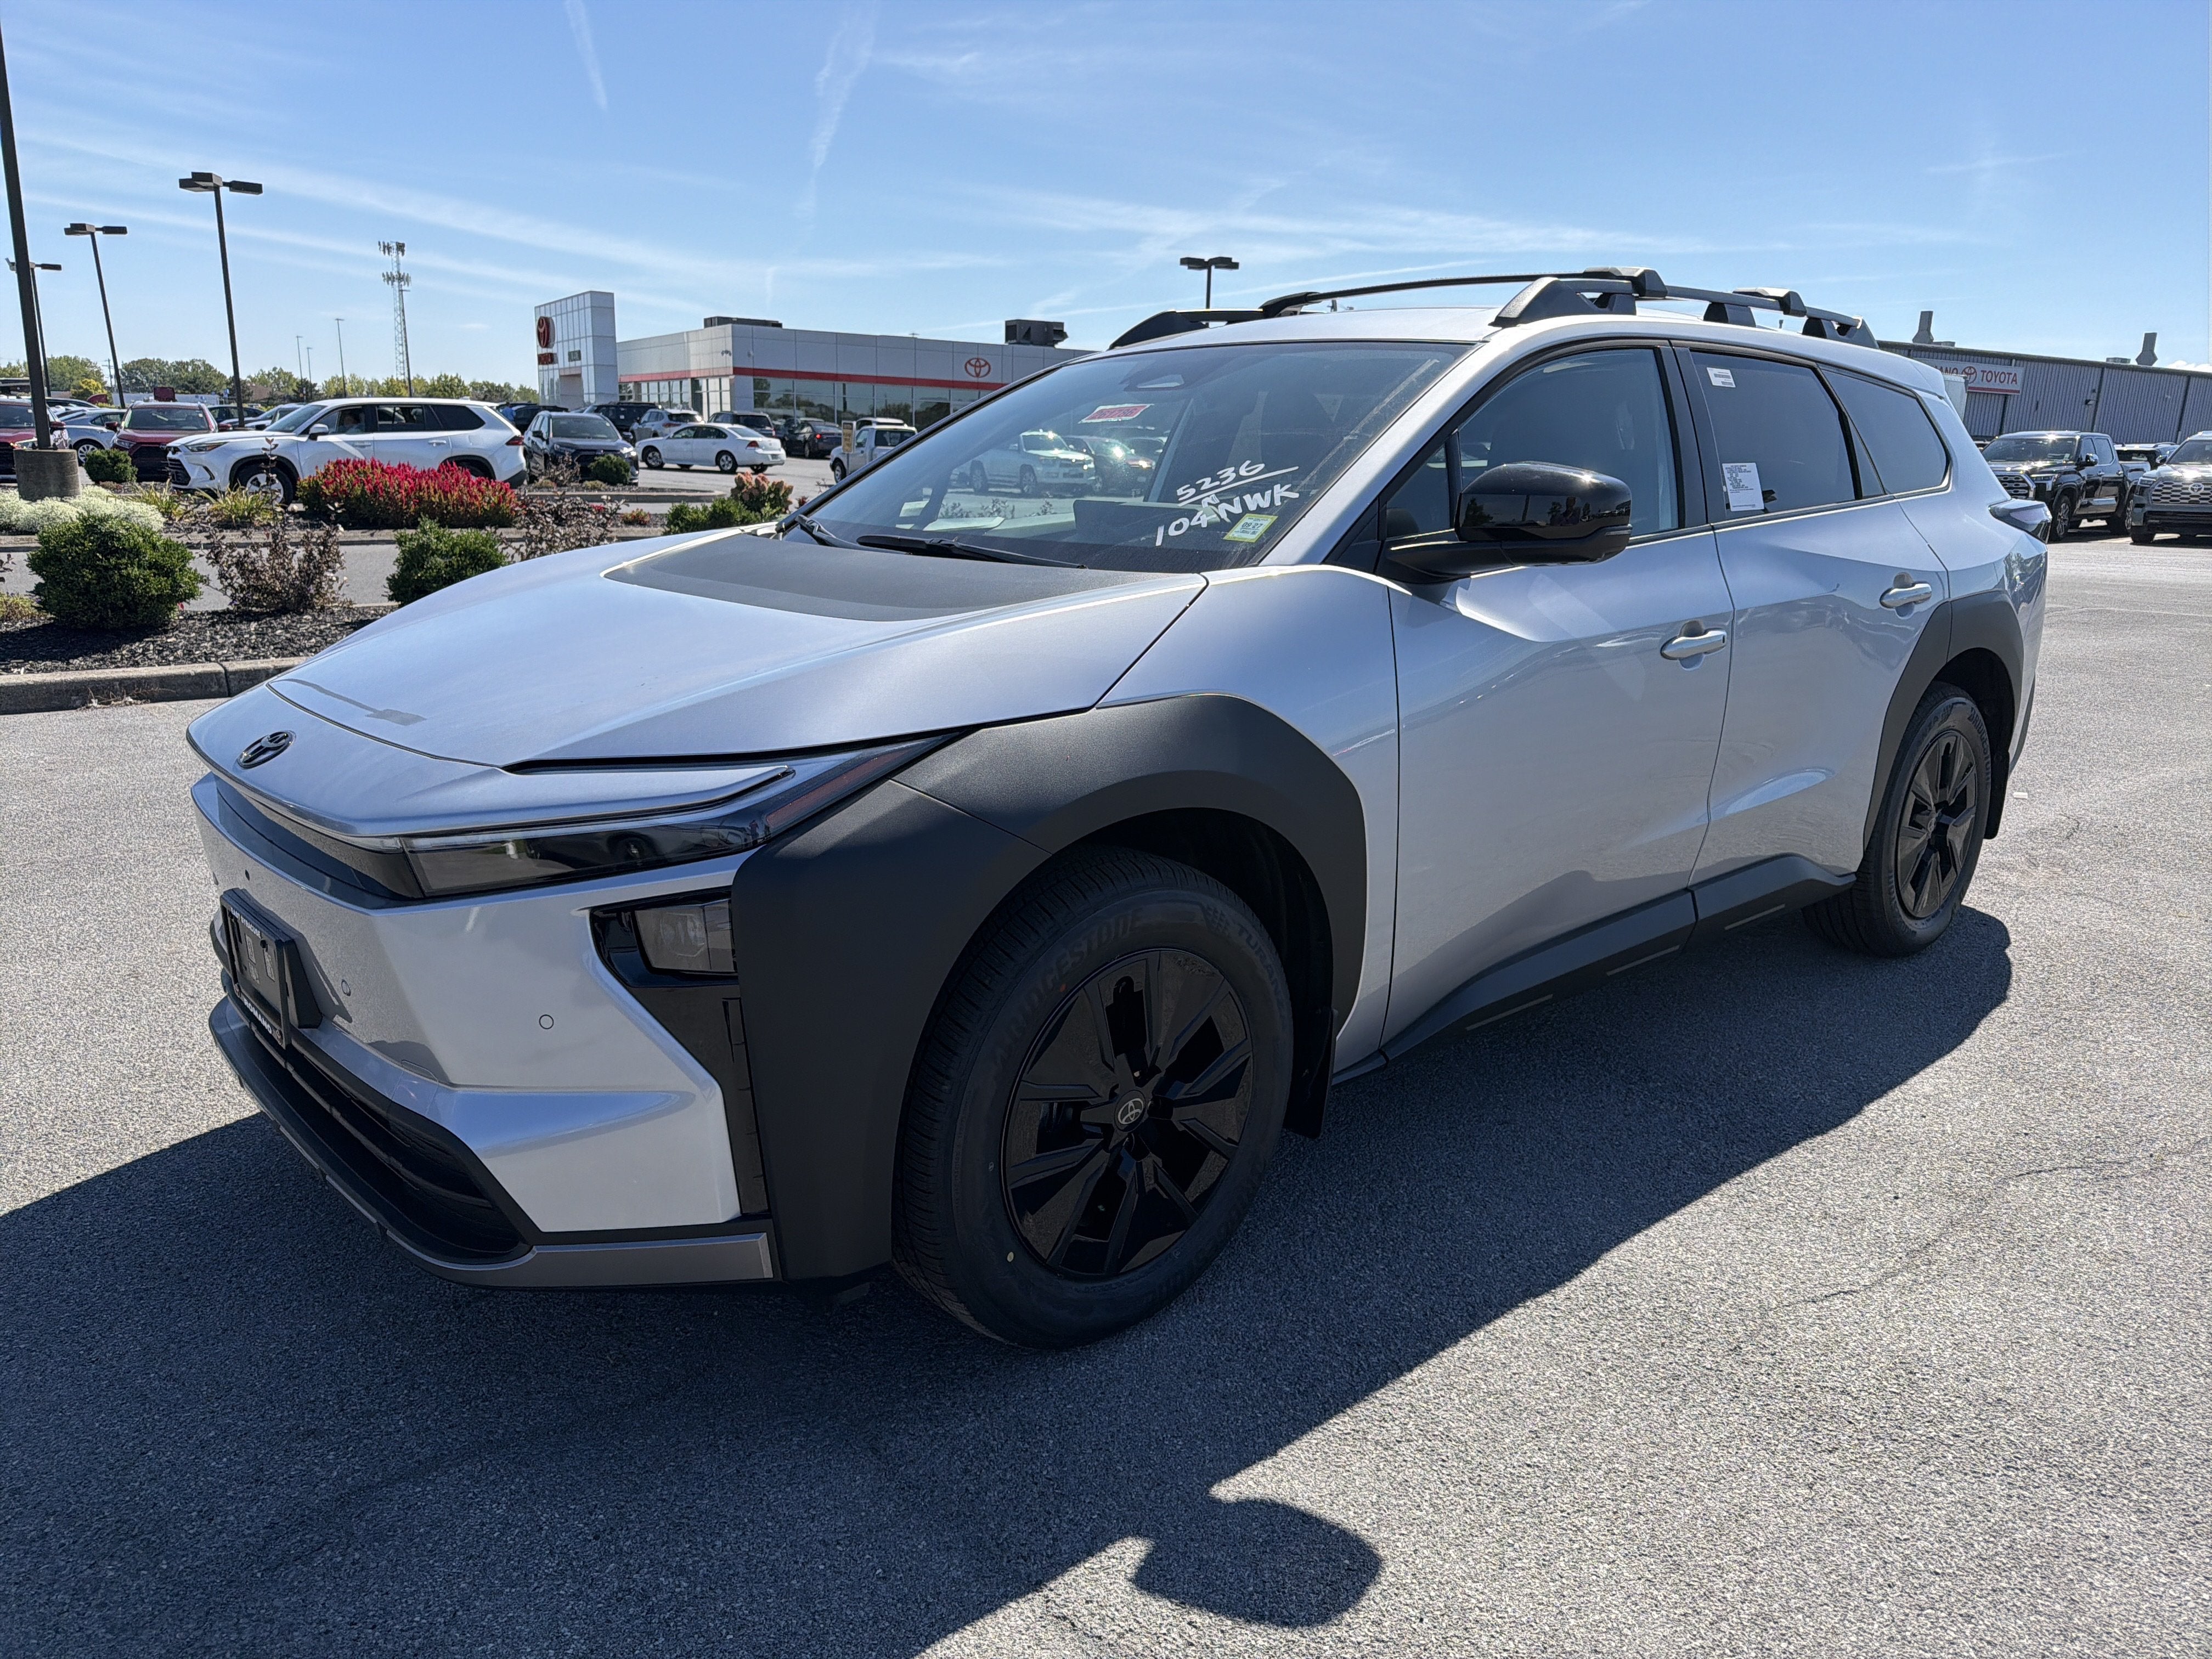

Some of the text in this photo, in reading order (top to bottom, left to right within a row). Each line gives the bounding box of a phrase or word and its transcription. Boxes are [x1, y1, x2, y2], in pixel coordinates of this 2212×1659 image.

[1980, 370, 2018, 384] TOYOTA
[1176, 460, 1265, 501] 5236
[243, 997, 273, 1035] ROMANO
